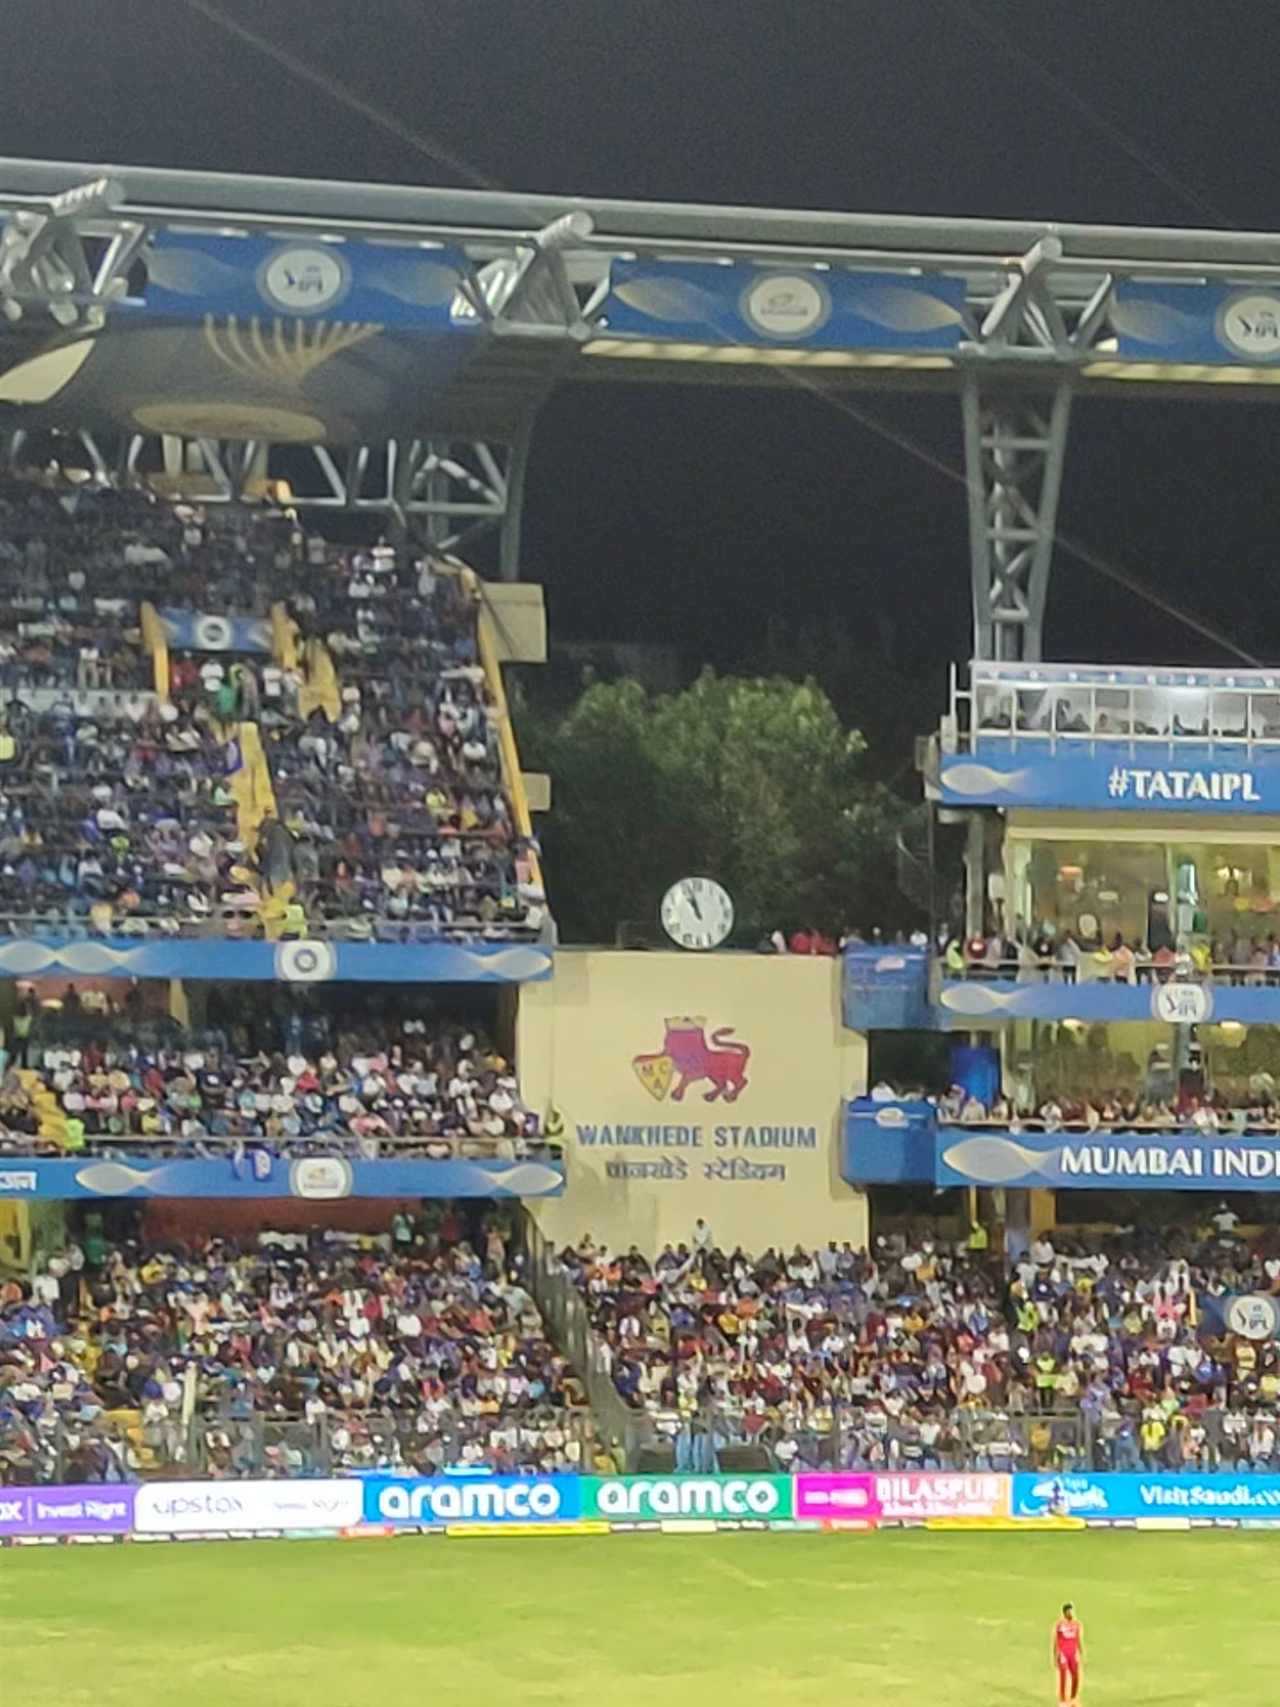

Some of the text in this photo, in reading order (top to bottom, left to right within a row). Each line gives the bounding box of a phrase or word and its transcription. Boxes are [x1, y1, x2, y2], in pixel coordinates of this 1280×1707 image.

[1108, 767, 1260, 801] #TATAIPL
[576, 1125, 816, 1148] WANKHEDE STADIUM
[1061, 1147, 1201, 1175] MUMBAI
[379, 1484, 561, 1519] aramco
[597, 1480, 779, 1514] aramco
